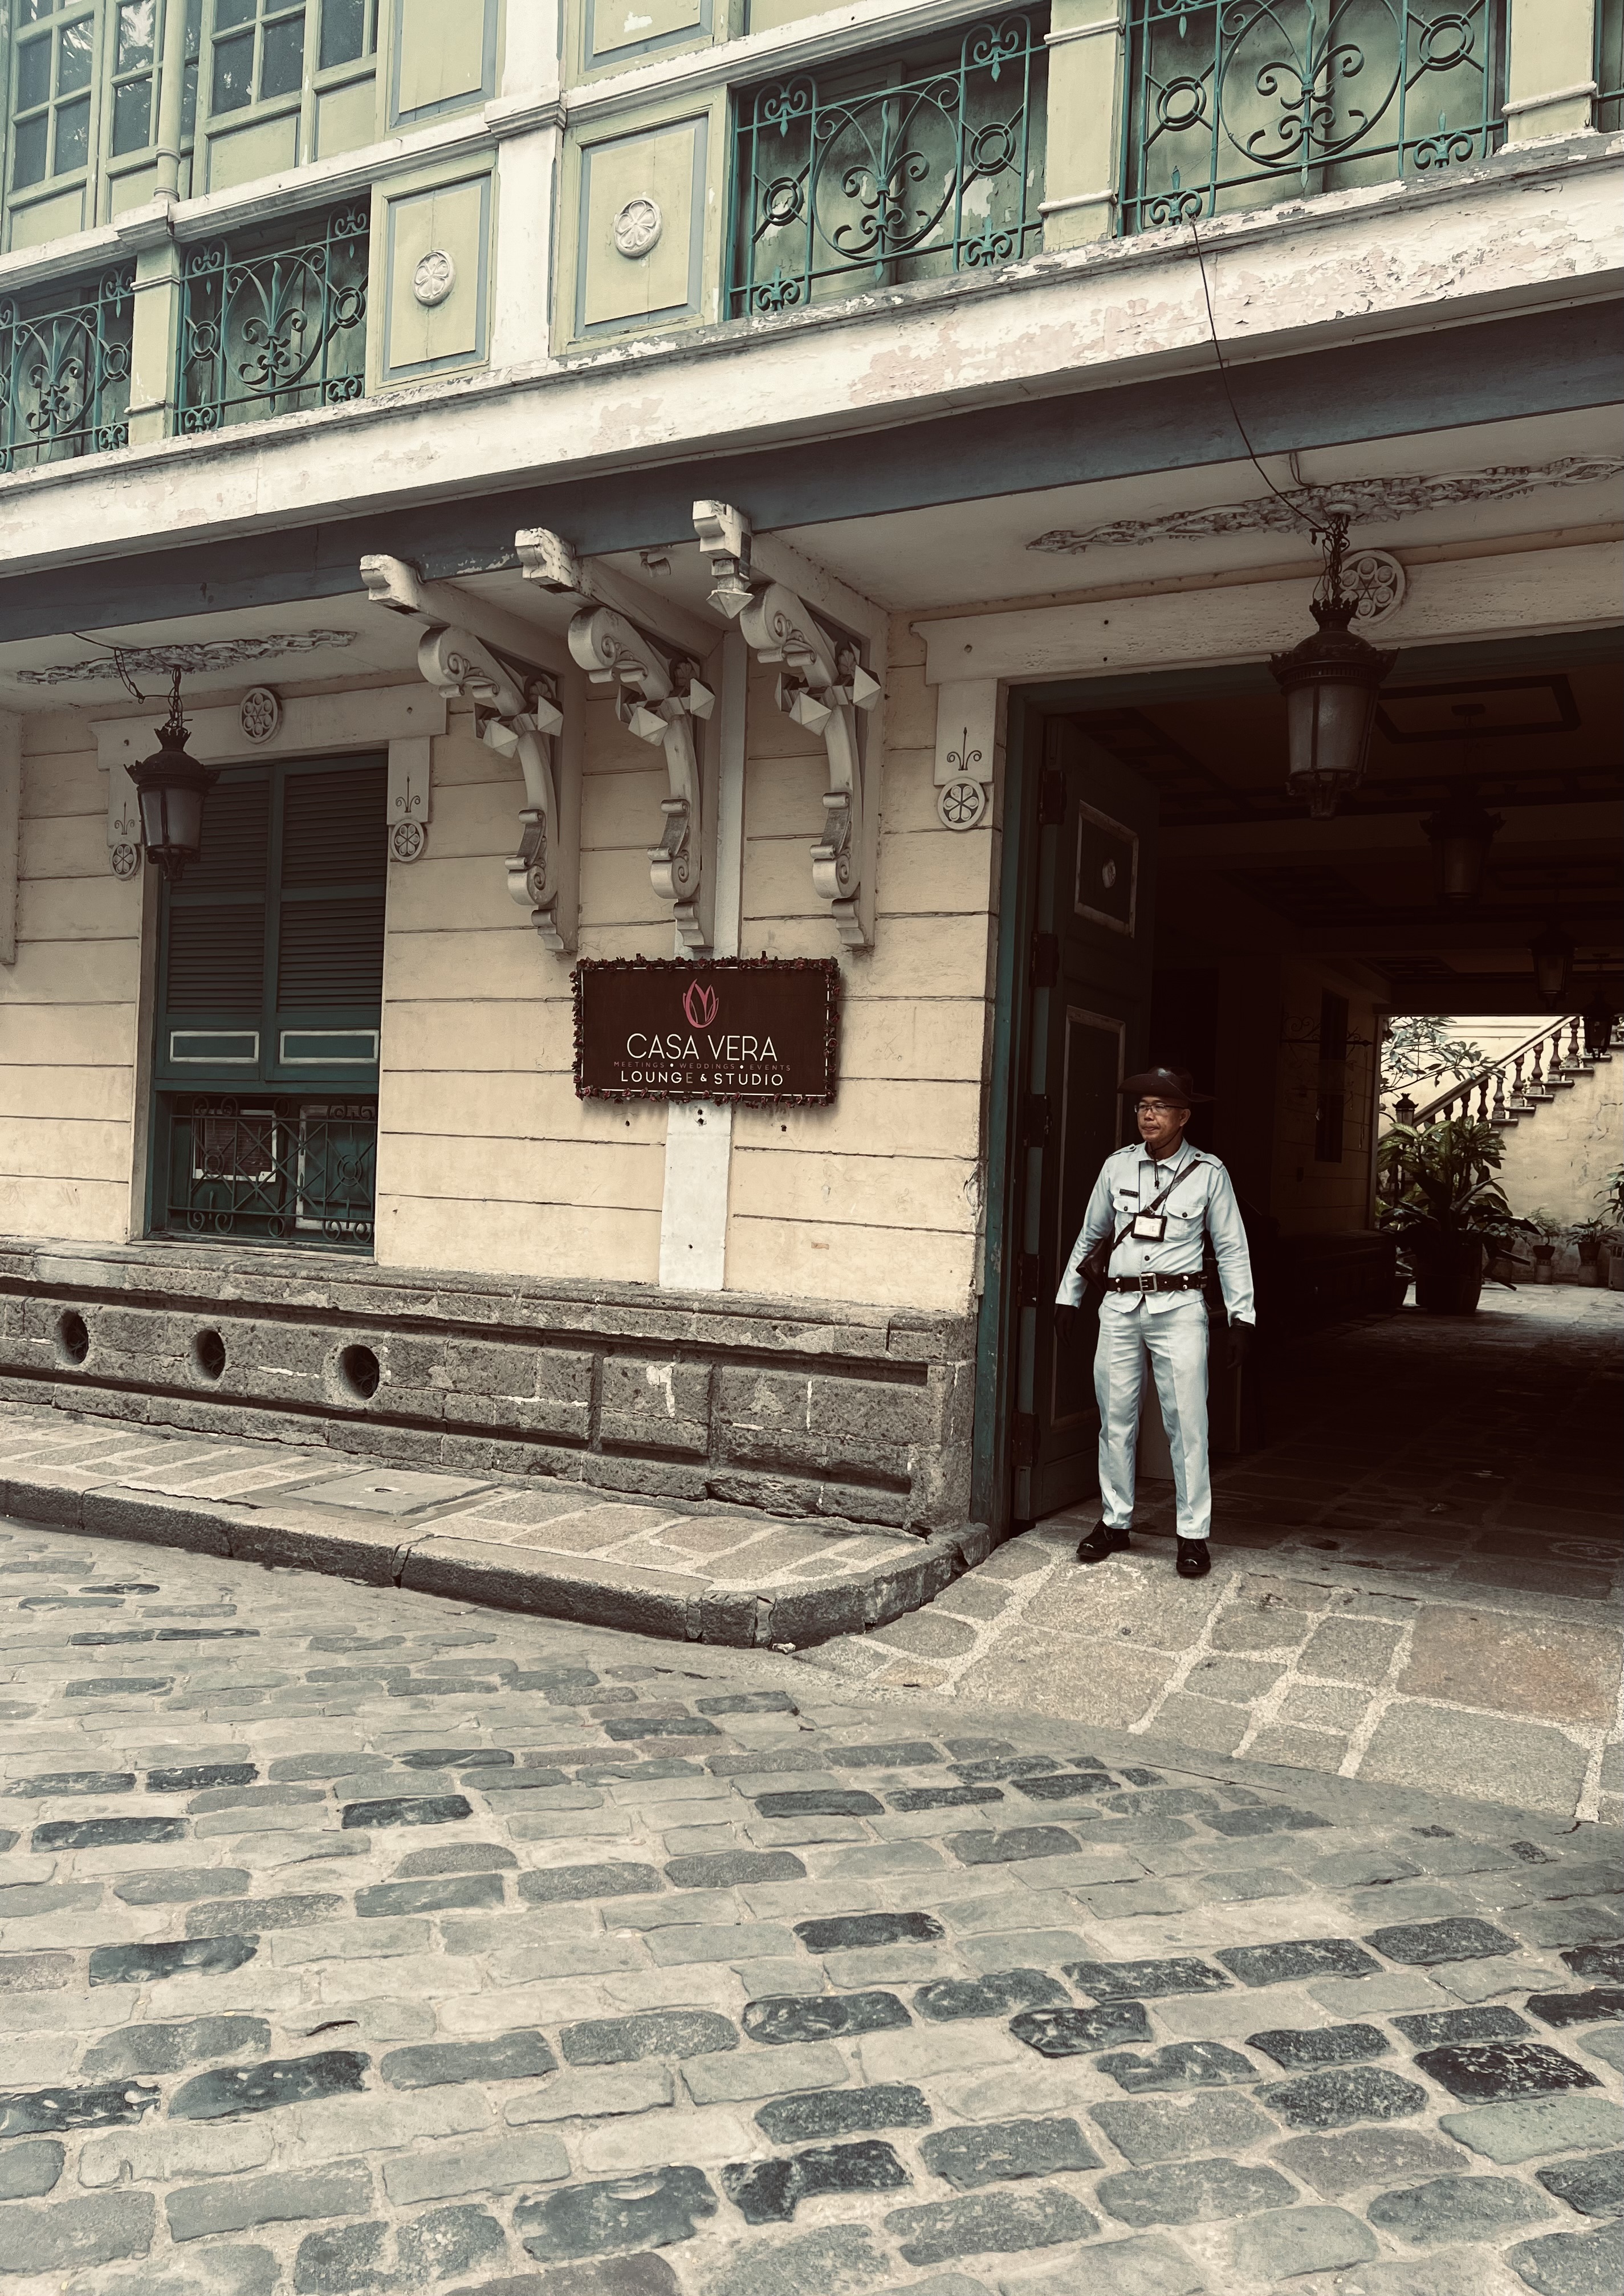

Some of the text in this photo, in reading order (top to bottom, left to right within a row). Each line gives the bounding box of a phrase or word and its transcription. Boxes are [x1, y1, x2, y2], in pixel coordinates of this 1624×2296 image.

[626, 1033, 778, 1062] CASA VERA
[621, 1070, 784, 1086] LOUNGE & STUDIO
